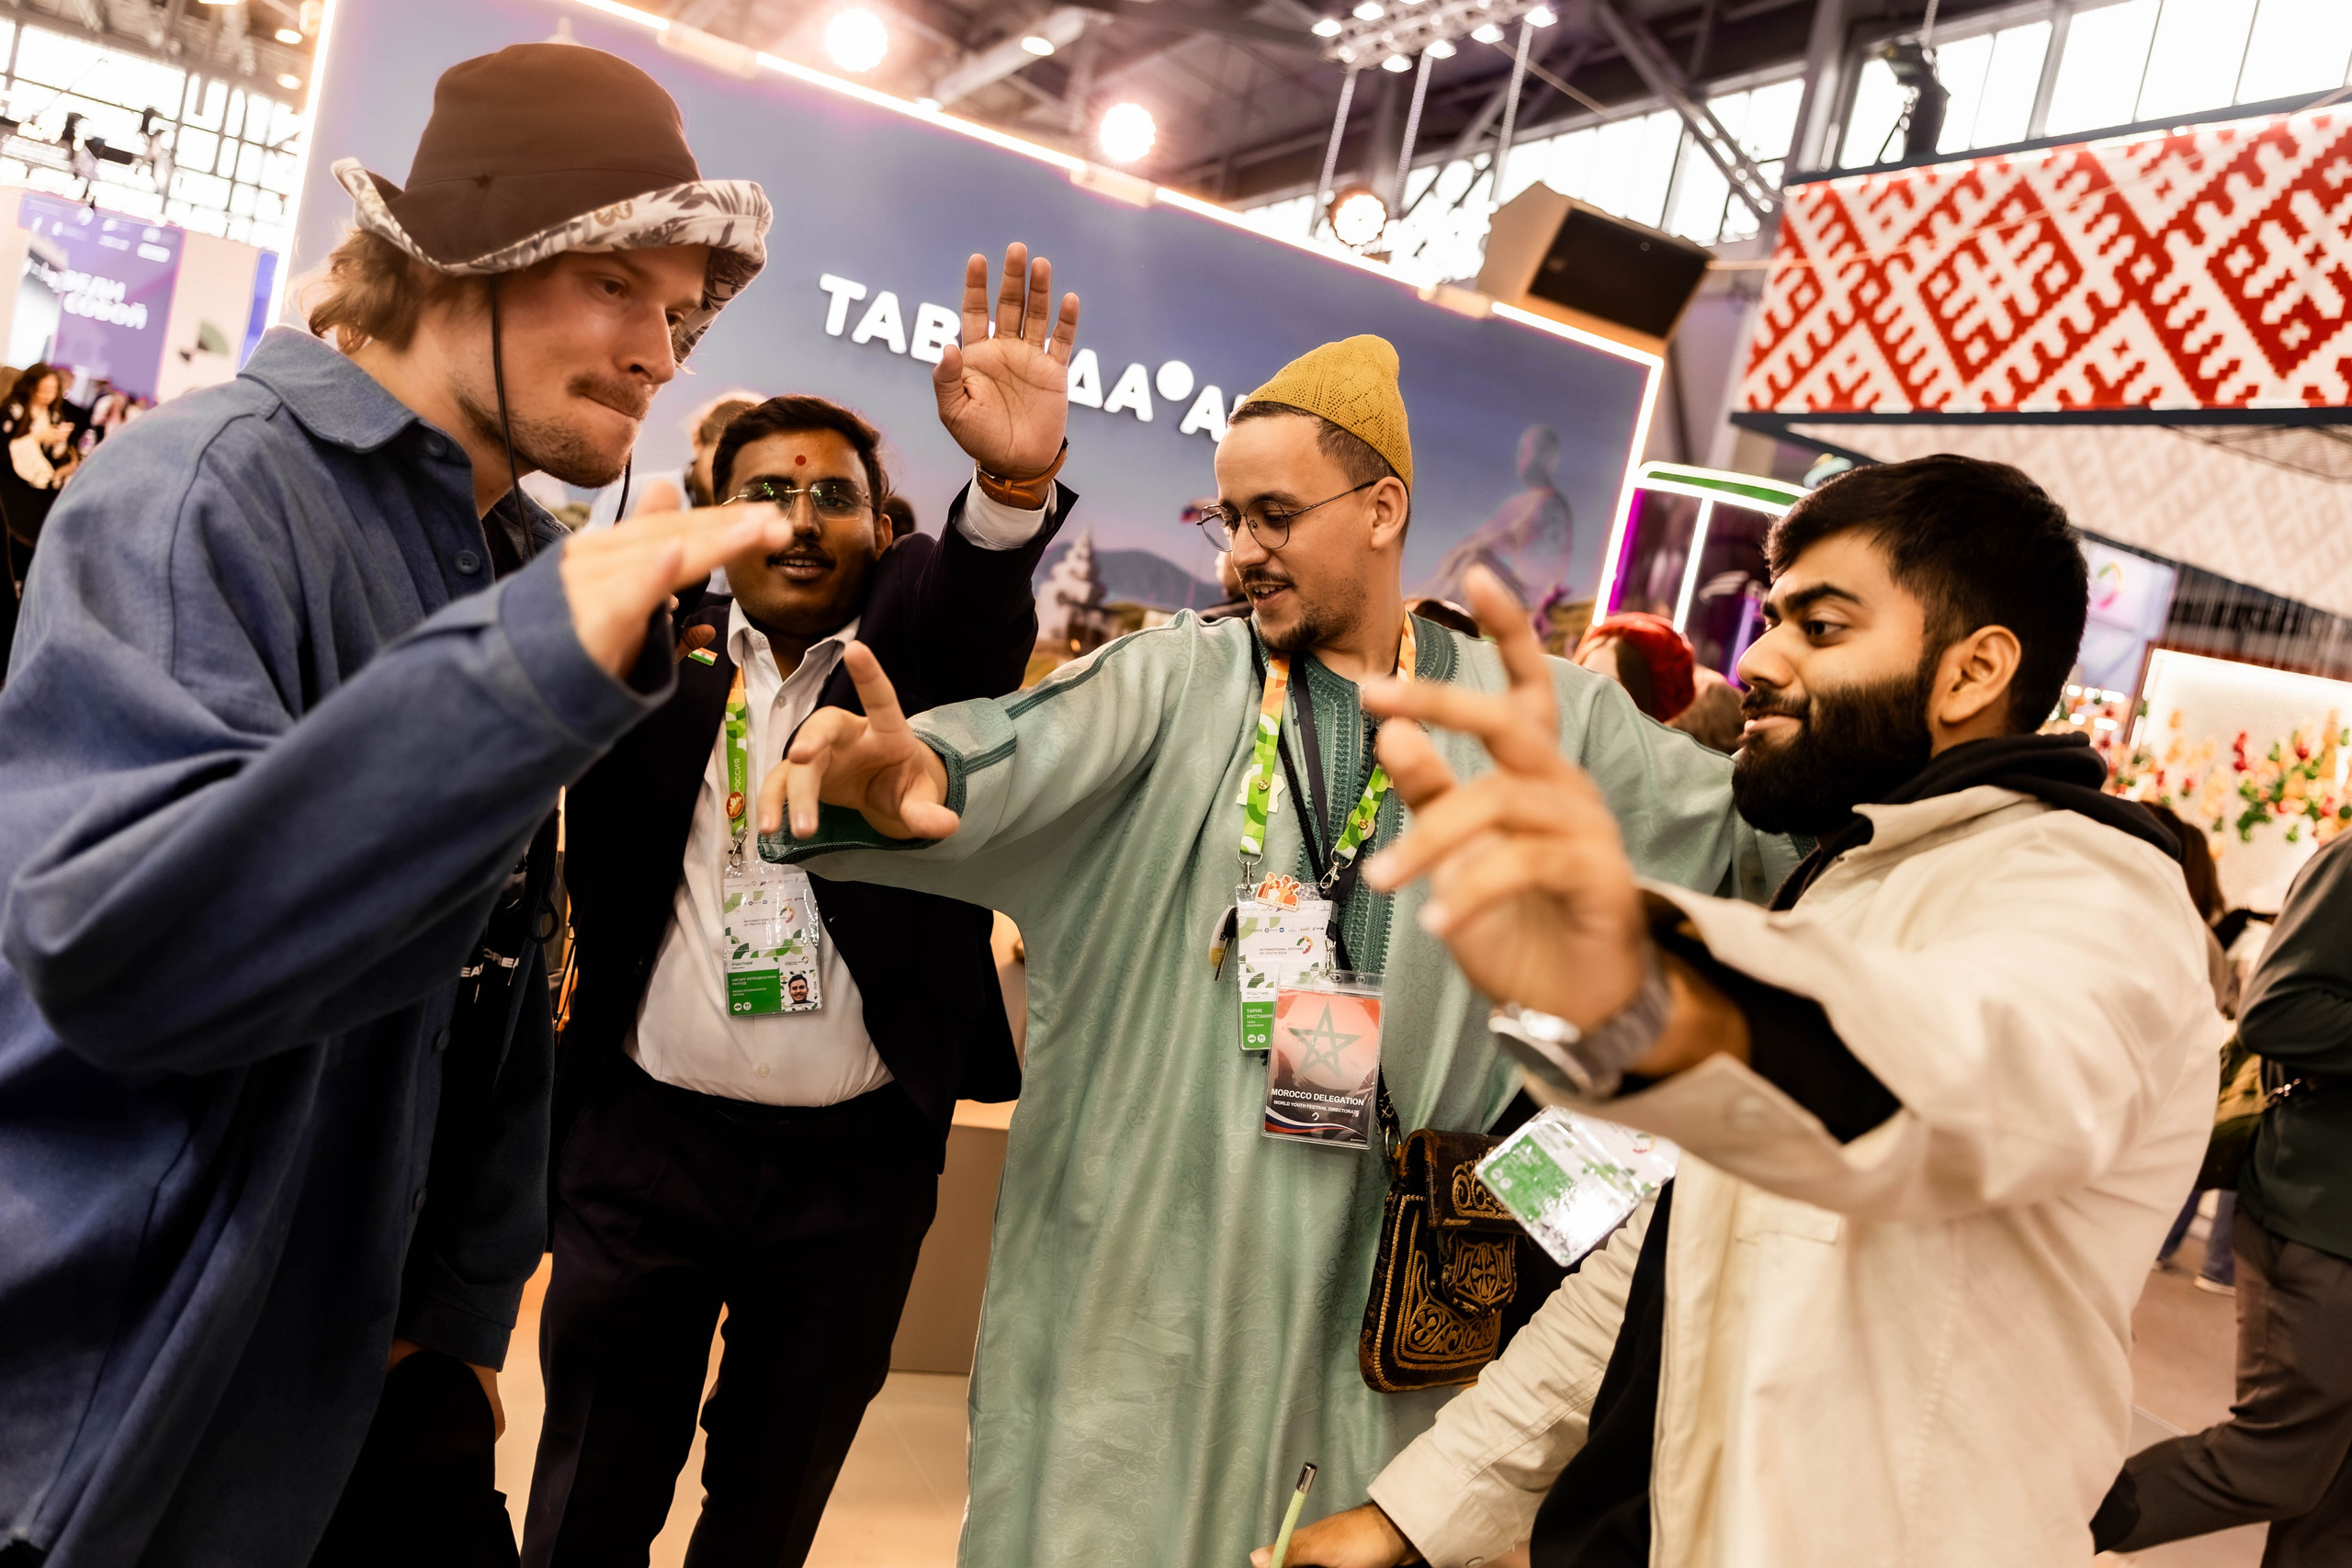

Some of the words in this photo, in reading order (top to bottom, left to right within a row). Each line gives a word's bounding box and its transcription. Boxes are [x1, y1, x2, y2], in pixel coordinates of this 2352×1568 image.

[1271, 1088, 1312, 1100] MOROCCO
[1313, 1093, 1364, 1107] DELEGATION
[1306, 1103, 1328, 1111] FESTIVAL
[1328, 1106, 1360, 1115] DIRECTORATE
